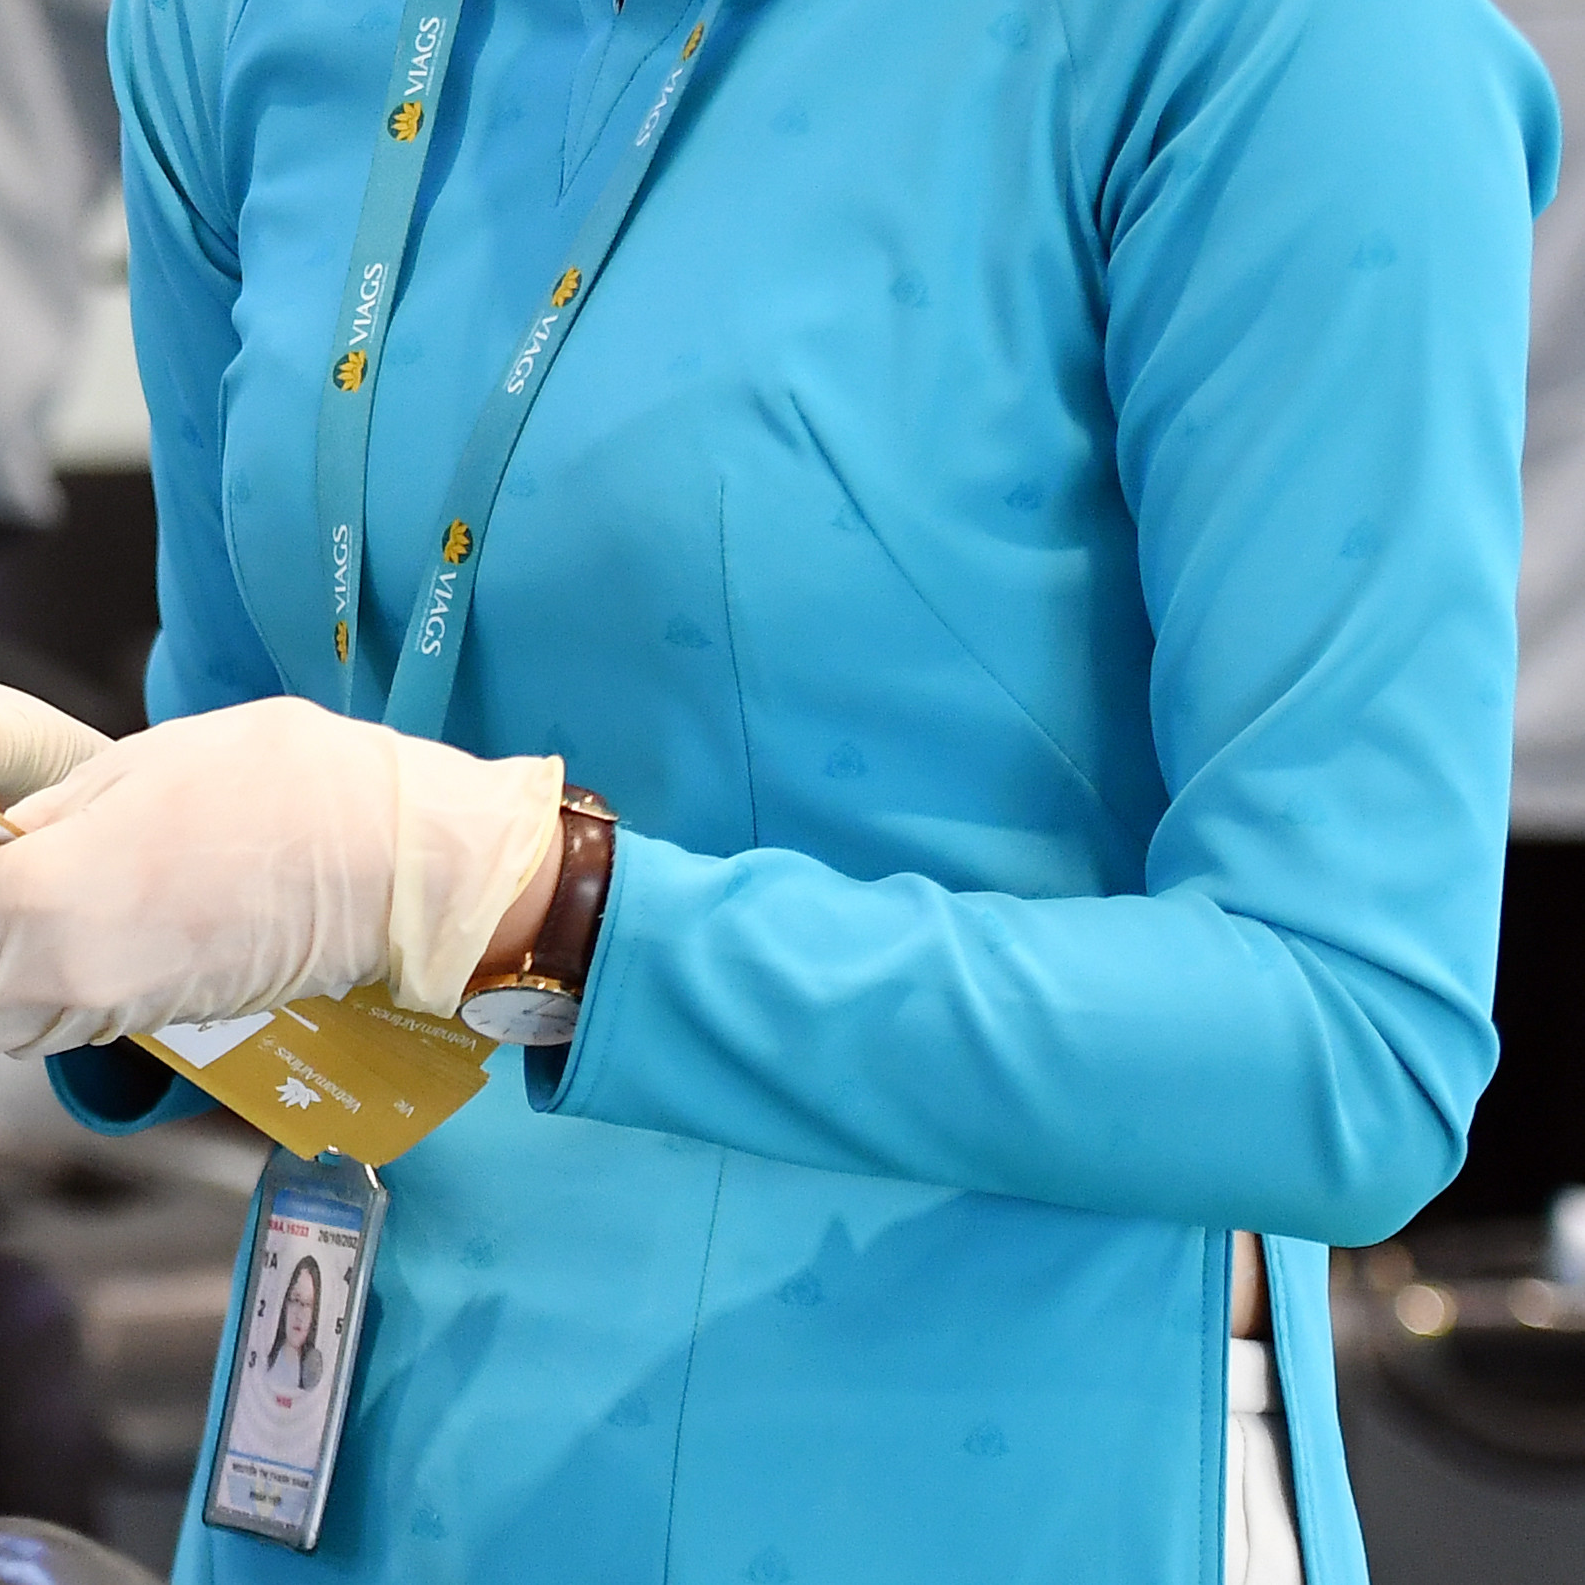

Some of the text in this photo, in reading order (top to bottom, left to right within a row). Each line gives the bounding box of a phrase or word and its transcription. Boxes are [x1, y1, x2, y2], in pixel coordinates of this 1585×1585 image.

[404, 16, 442, 97] VIAGS
[635, 69, 683, 149] VIAGS
[350, 262, 384, 346] VIAGS
[506, 314, 558, 396] VIAGS
[334, 524, 348, 613] VIAGS
[420, 572, 457, 657] VIAGS
[258, 1300, 266, 1317] 2
[335, 1318, 344, 1334] 5
